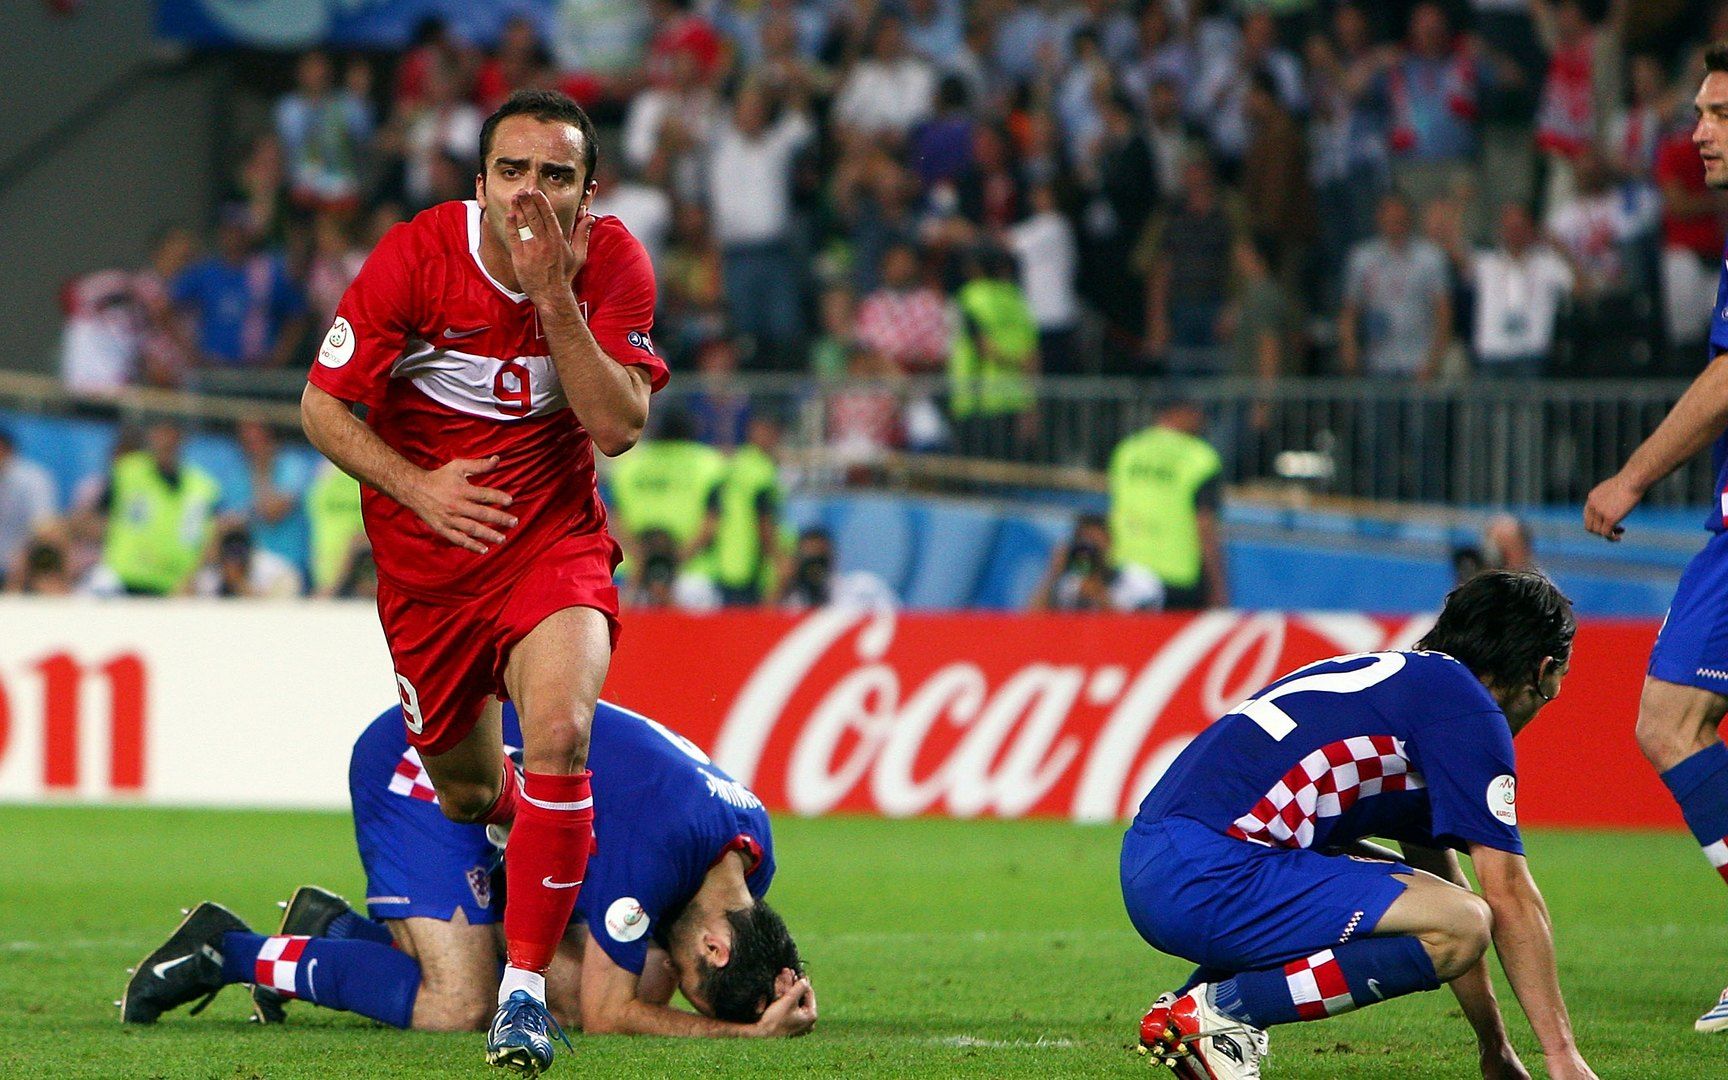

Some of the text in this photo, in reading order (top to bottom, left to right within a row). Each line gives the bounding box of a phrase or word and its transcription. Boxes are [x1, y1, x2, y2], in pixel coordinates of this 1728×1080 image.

[493, 362, 531, 417] 9
[396, 672, 423, 735] 9
[1226, 650, 1408, 742] 2
